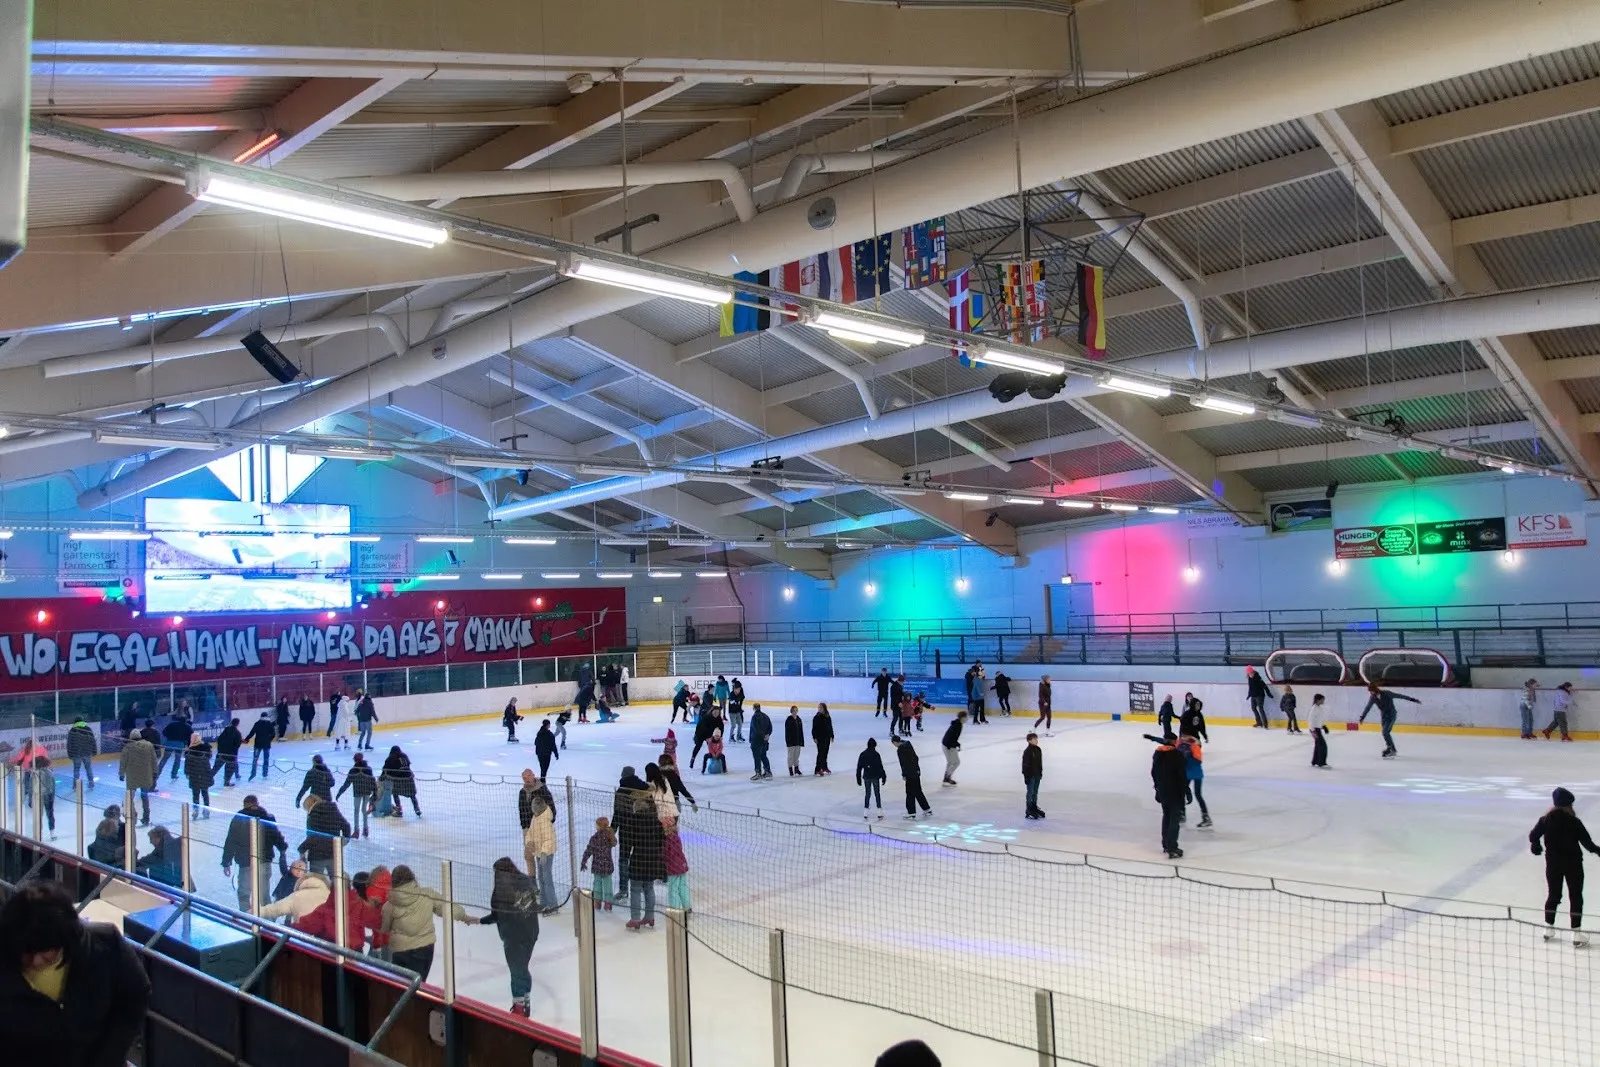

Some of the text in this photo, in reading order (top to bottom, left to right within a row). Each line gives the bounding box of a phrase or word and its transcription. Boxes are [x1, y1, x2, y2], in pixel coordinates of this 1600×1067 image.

[1518, 514, 1556, 532] KFS
[1338, 532, 1376, 540] HUNGER?
[63, 541, 82, 552] mgf
[360, 544, 375, 553] mgf
[63, 551, 120, 560] gartenstadt
[360, 553, 402, 561] gartenstadt
[64, 561, 104, 569] farmsen
[69, 631, 171, 674] EGAL
[166, 625, 261, 670] WANN
[278, 623, 362, 665] IMMER
[365, 624, 396, 658] DA
[399, 620, 442, 656] ALS
[445, 620, 460, 647] 7
[463, 616, 536, 652] MANN
